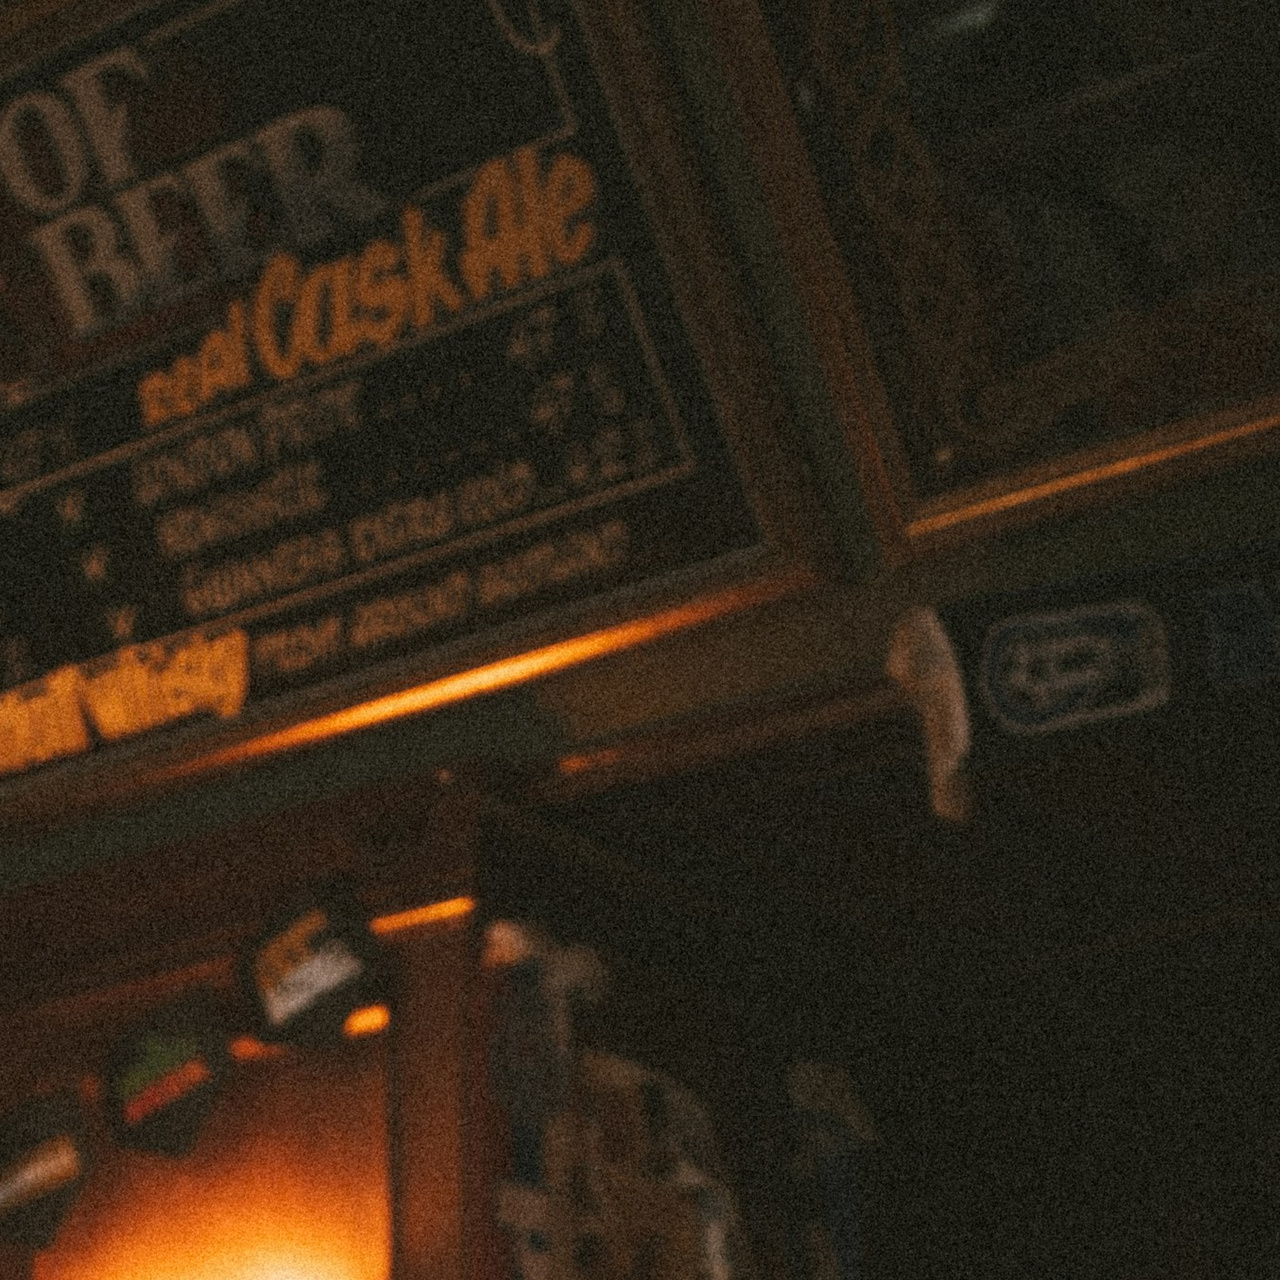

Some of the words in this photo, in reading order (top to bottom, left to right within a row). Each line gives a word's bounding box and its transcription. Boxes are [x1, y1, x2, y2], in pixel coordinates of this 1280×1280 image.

[32, 104, 386, 342] BEER
[253, 205, 462, 381] Cask
[460, 144, 600, 300] Ale
